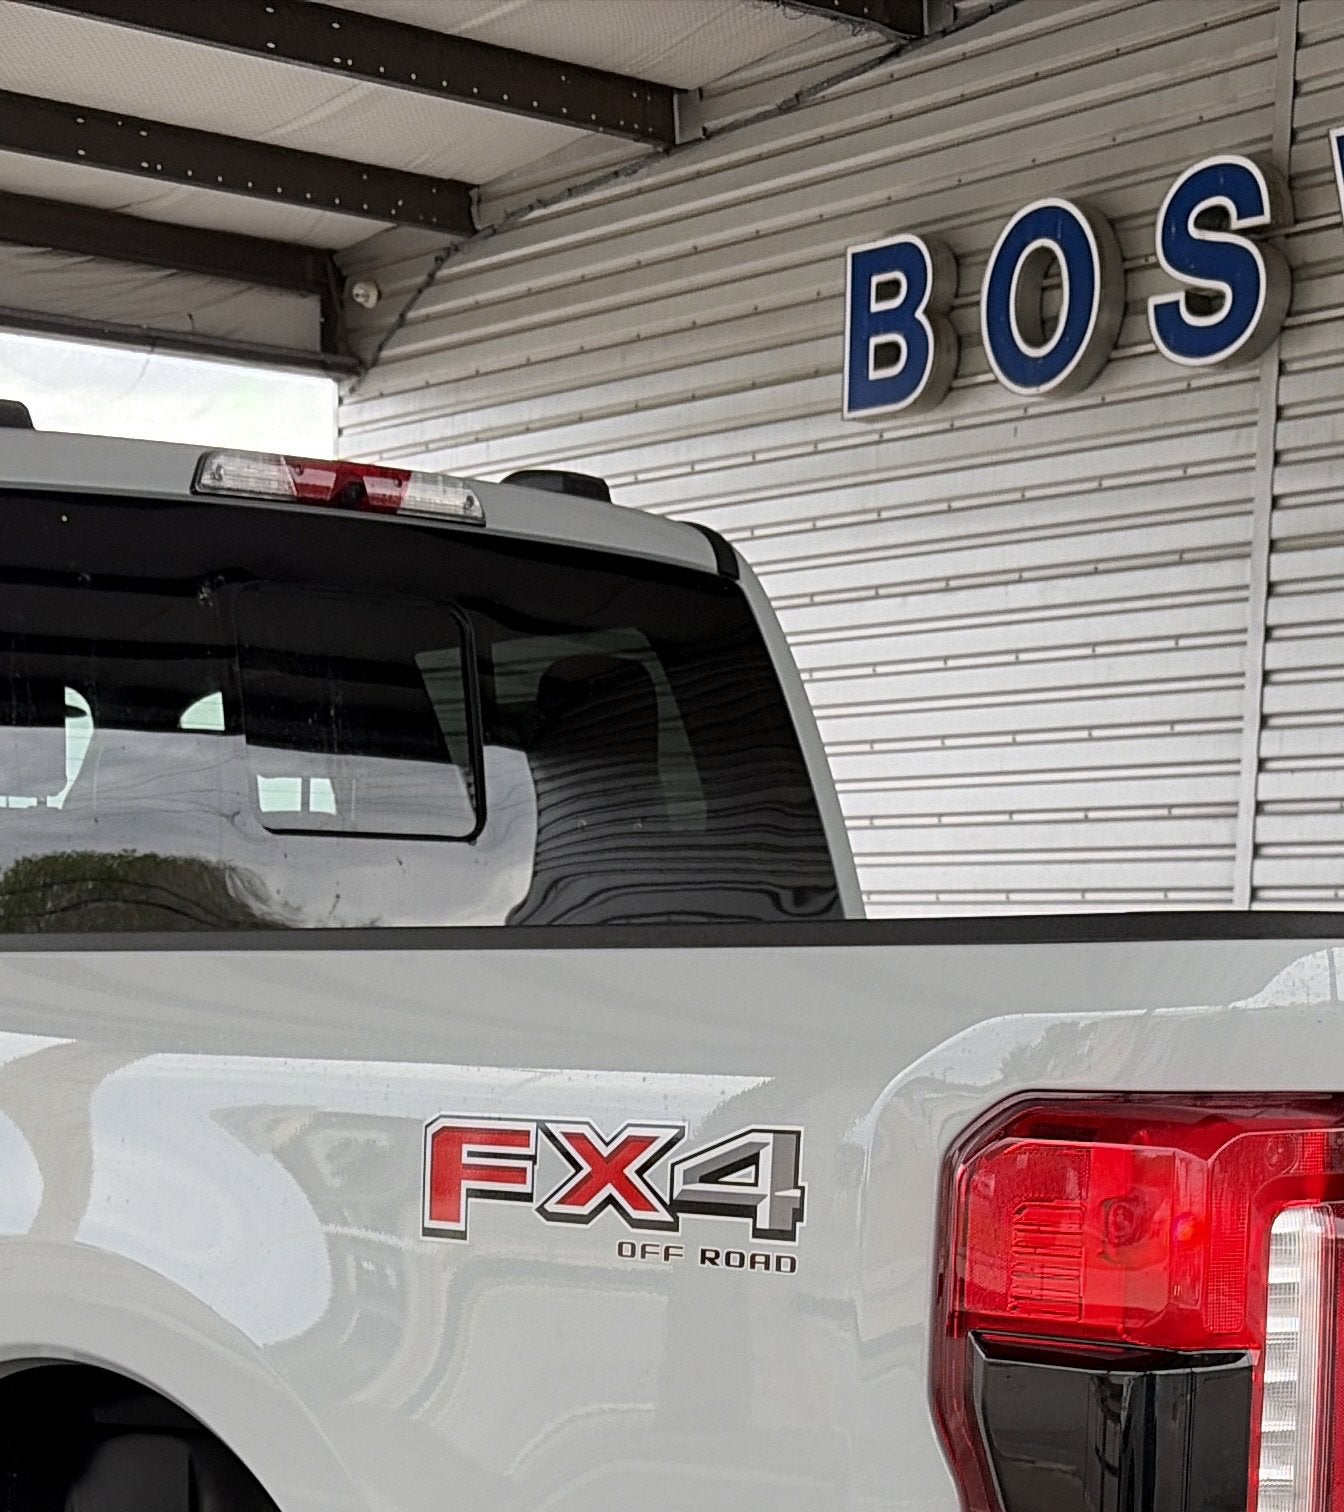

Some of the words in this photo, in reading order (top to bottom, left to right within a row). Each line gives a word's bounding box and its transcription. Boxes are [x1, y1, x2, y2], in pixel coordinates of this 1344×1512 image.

[420, 1113, 807, 1245] FX4
[617, 1240, 685, 1263] OFF
[699, 1246, 799, 1275] ROAD
